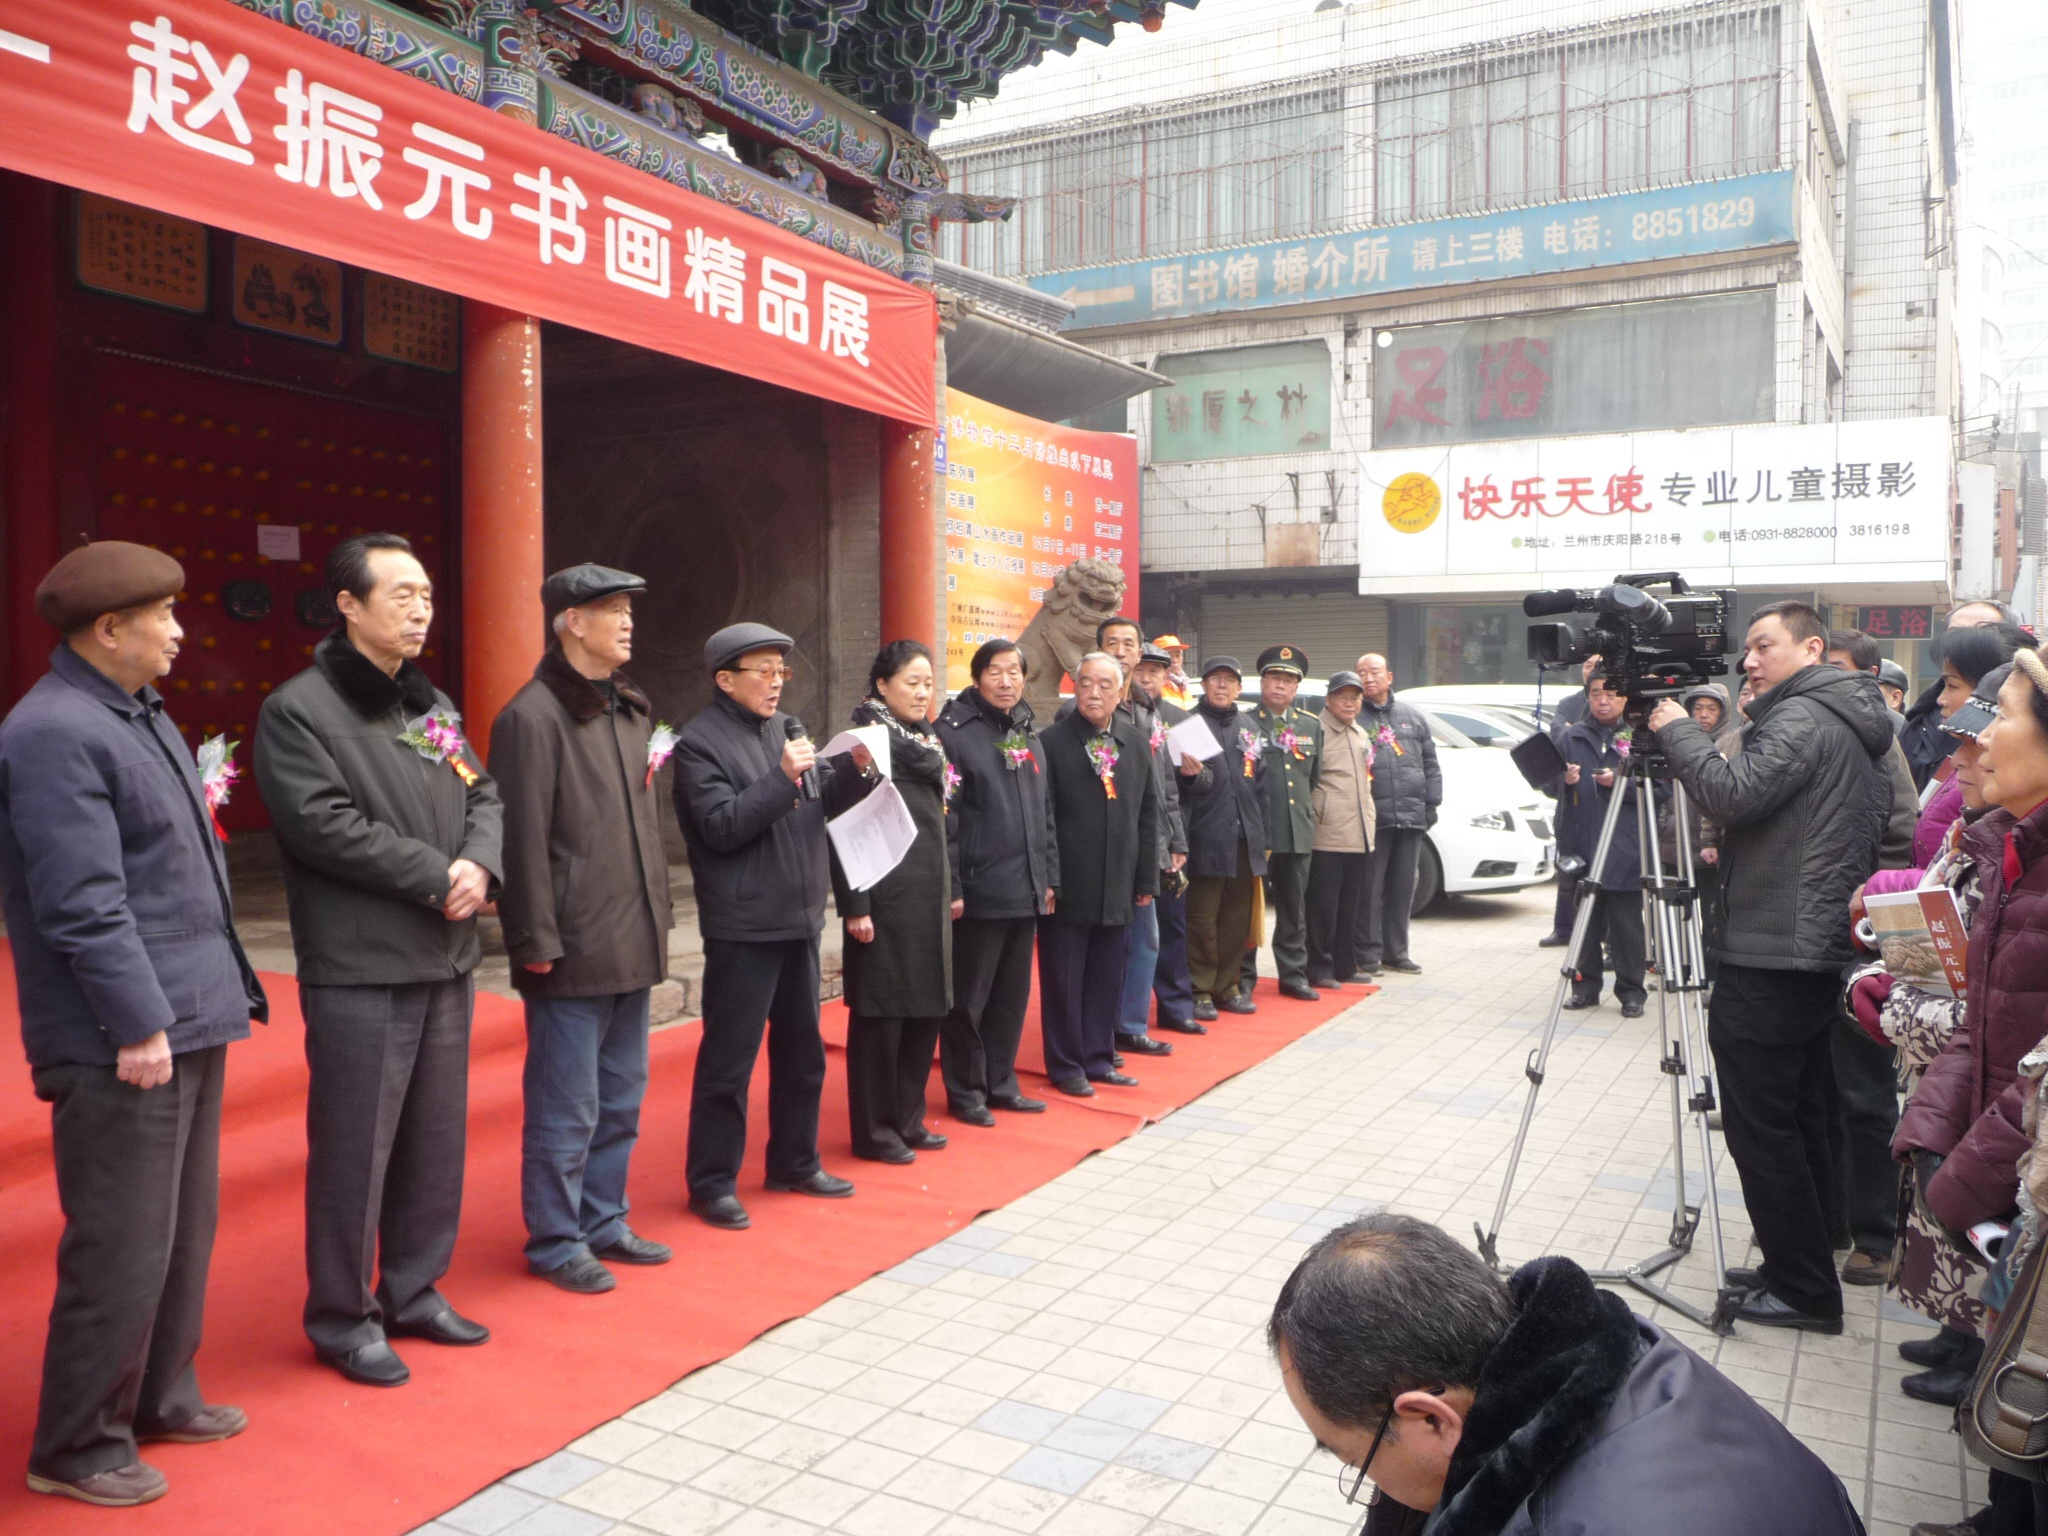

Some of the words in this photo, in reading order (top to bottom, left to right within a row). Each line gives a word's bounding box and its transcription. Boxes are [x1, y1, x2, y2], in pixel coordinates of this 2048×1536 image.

[126, 15, 870, 367] 赵振元书画精品展
[1150, 253, 1259, 311] 图书馆
[1272, 234, 1391, 294] 婚介所
[1412, 225, 1524, 271] 请上三楼
[1632, 196, 1755, 241] 8851829
[1457, 466, 1653, 521] 快乐天使
[1660, 460, 1918, 507] 专业儿童摄影
[1849, 523, 1910, 536] 3816198
[1866, 609, 1927, 636] 足浴
